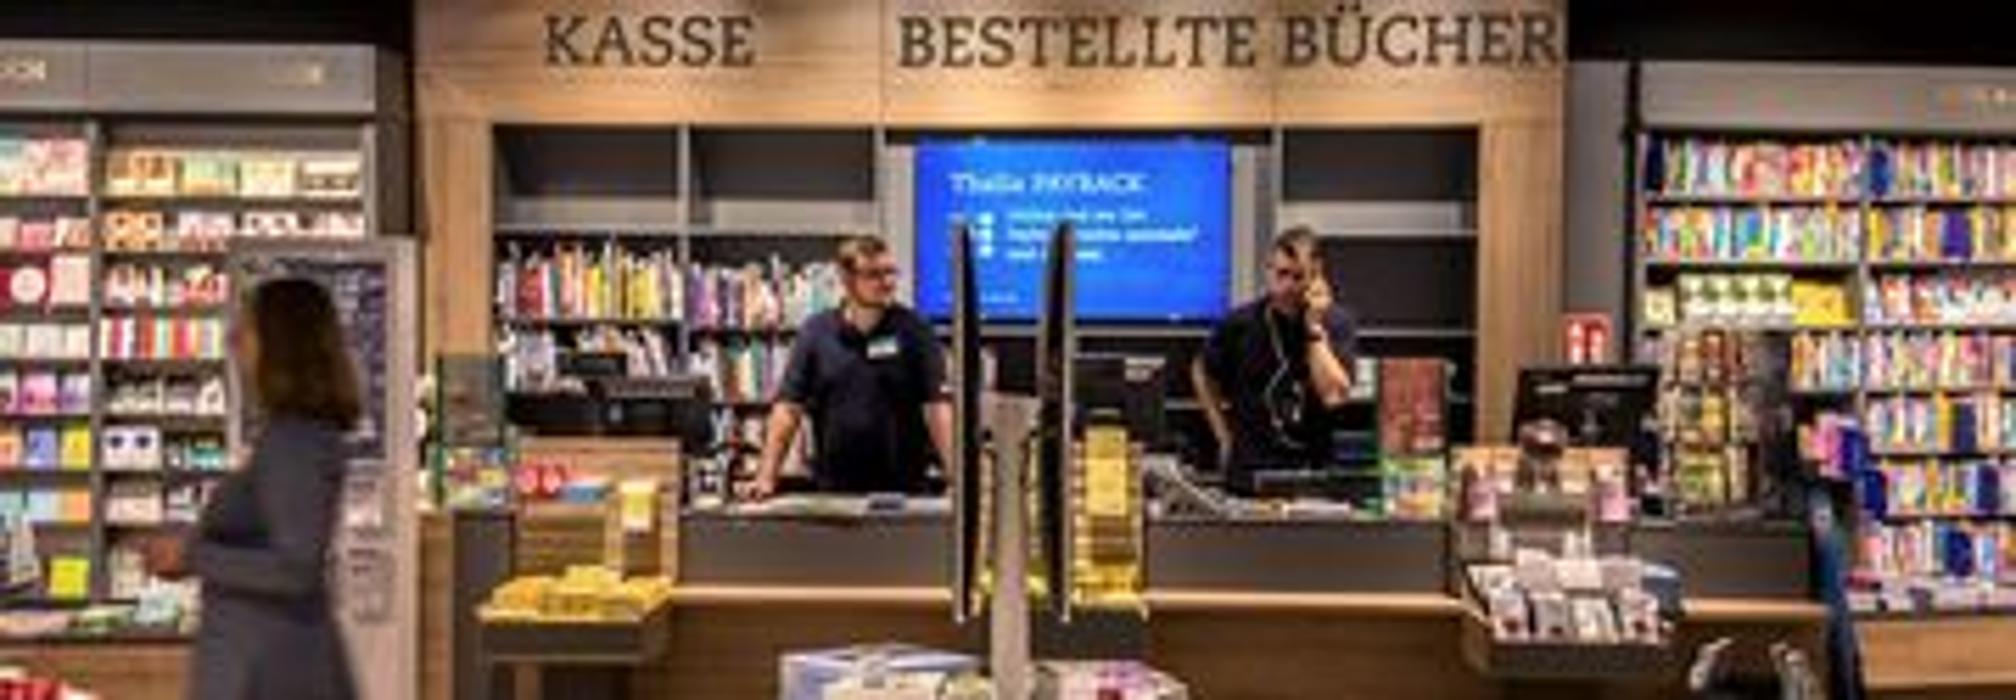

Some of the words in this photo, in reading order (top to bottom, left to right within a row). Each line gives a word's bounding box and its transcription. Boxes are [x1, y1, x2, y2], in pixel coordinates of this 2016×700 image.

[544, 15, 755, 67] KASSE
[898, 15, 1256, 68] BESTELLTE
[1283, 2, 1560, 66] BÜCHER
